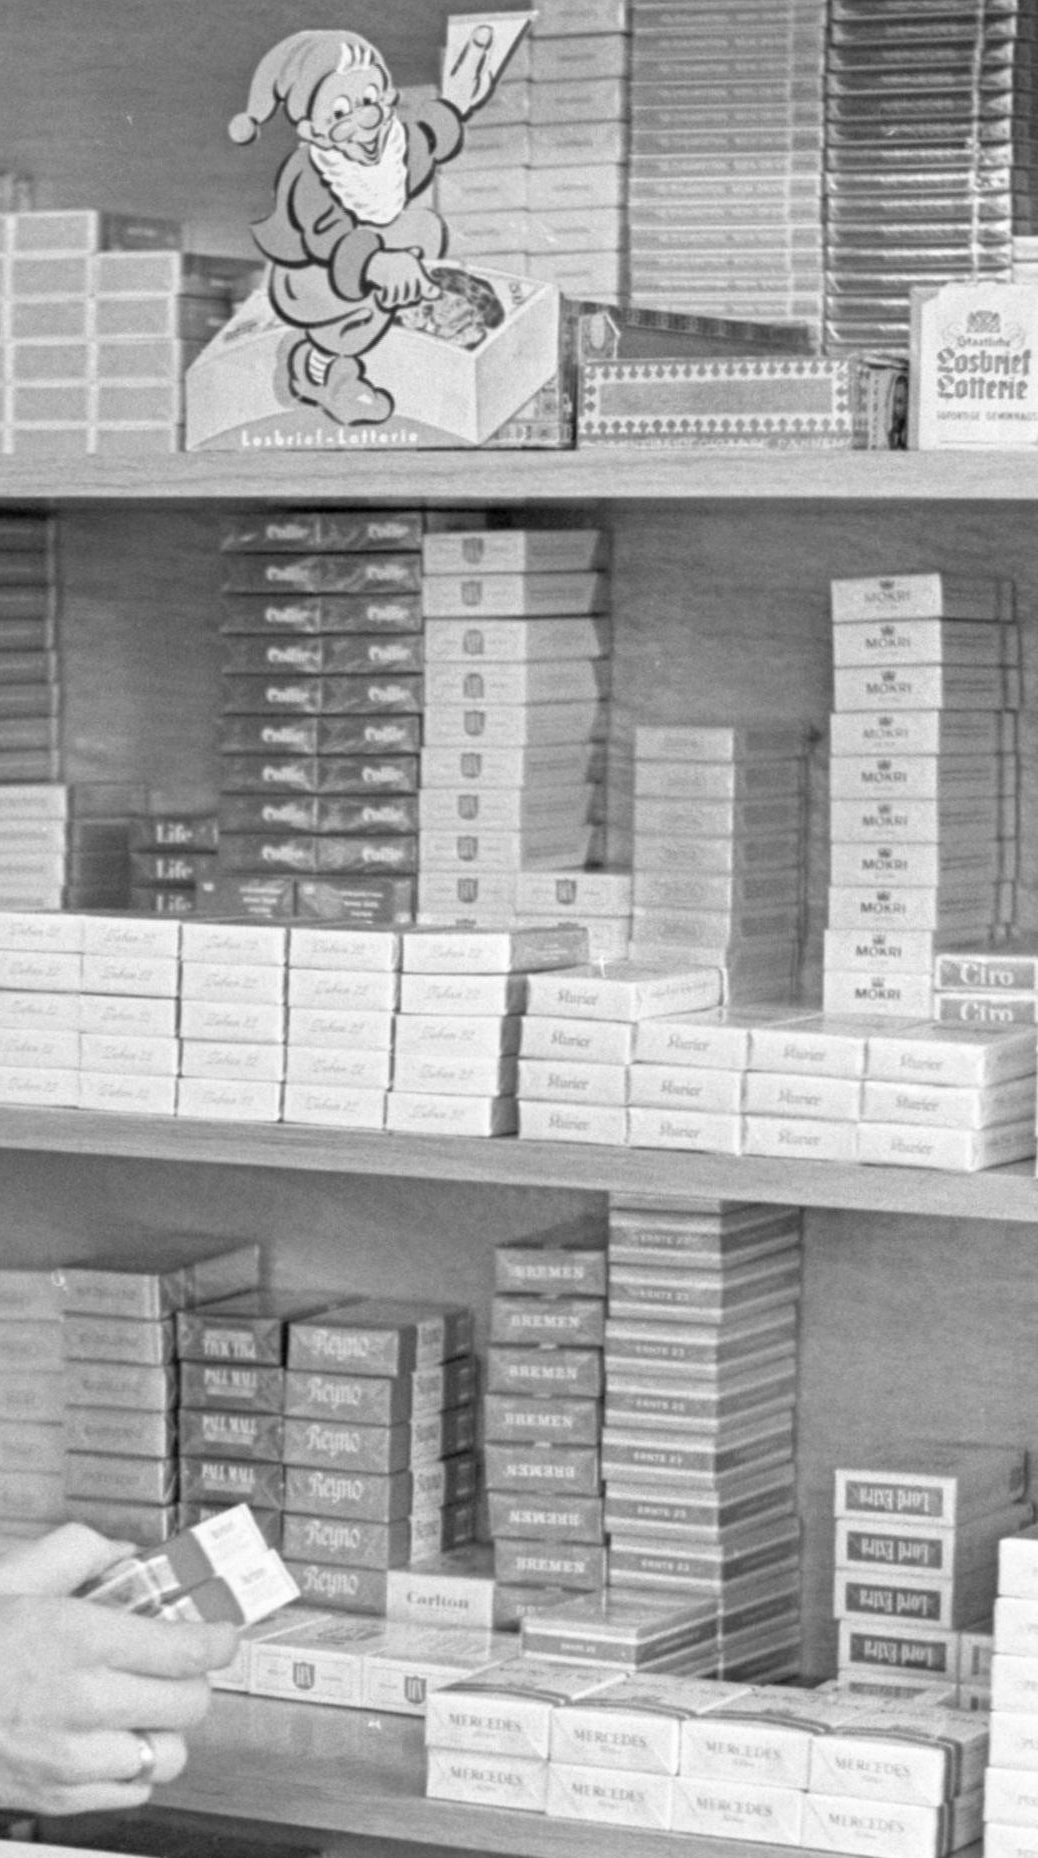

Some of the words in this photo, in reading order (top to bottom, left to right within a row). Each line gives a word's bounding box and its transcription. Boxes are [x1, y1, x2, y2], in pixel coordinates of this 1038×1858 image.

[937, 348, 1032, 375] Losbrief
[937, 374, 1028, 400] Lotterie
[241, 427, 419, 447] Losbrief-Lotterie
[866, 637, 911, 649] MOKRI
[866, 683, 912, 695] MOKRI
[862, 771, 908, 784] MOKRI
[862, 816, 908, 826] MOKRI
[157, 823, 193, 844] Life
[156, 859, 193, 879] Life
[862, 859, 908, 871] MOKRI
[860, 902, 906, 914] MOKRI
[855, 945, 902, 957] MOKRI
[960, 962, 1014, 986] Ciro
[855, 988, 900, 1000] MOKRI
[511, 1315, 580, 1328] BREMEN
[312, 1328, 369, 1361] Reyno
[509, 1364, 578, 1380] BREMEN
[307, 1376, 363, 1410] Reyno
[306, 1424, 361, 1457] Reyno
[308, 1472, 363, 1504] Reyno
[306, 1519, 361, 1552] Reyno
[516, 1557, 585, 1573] BREMEN
[303, 1565, 360, 1597] Reyno
[406, 1592, 470, 1610] Carlton
[449, 1712, 522, 1733] MERCEDES
[573, 1728, 648, 1748] MERCEDES
[705, 1740, 782, 1760] MERCEDES
[450, 1766, 524, 1786] MERCEDES
[834, 1756, 911, 1778] MERCEDES
[571, 1782, 646, 1802] MERCEDES
[696, 1796, 773, 1817] MERCEDES
[828, 1812, 905, 1833] MERCEDES
